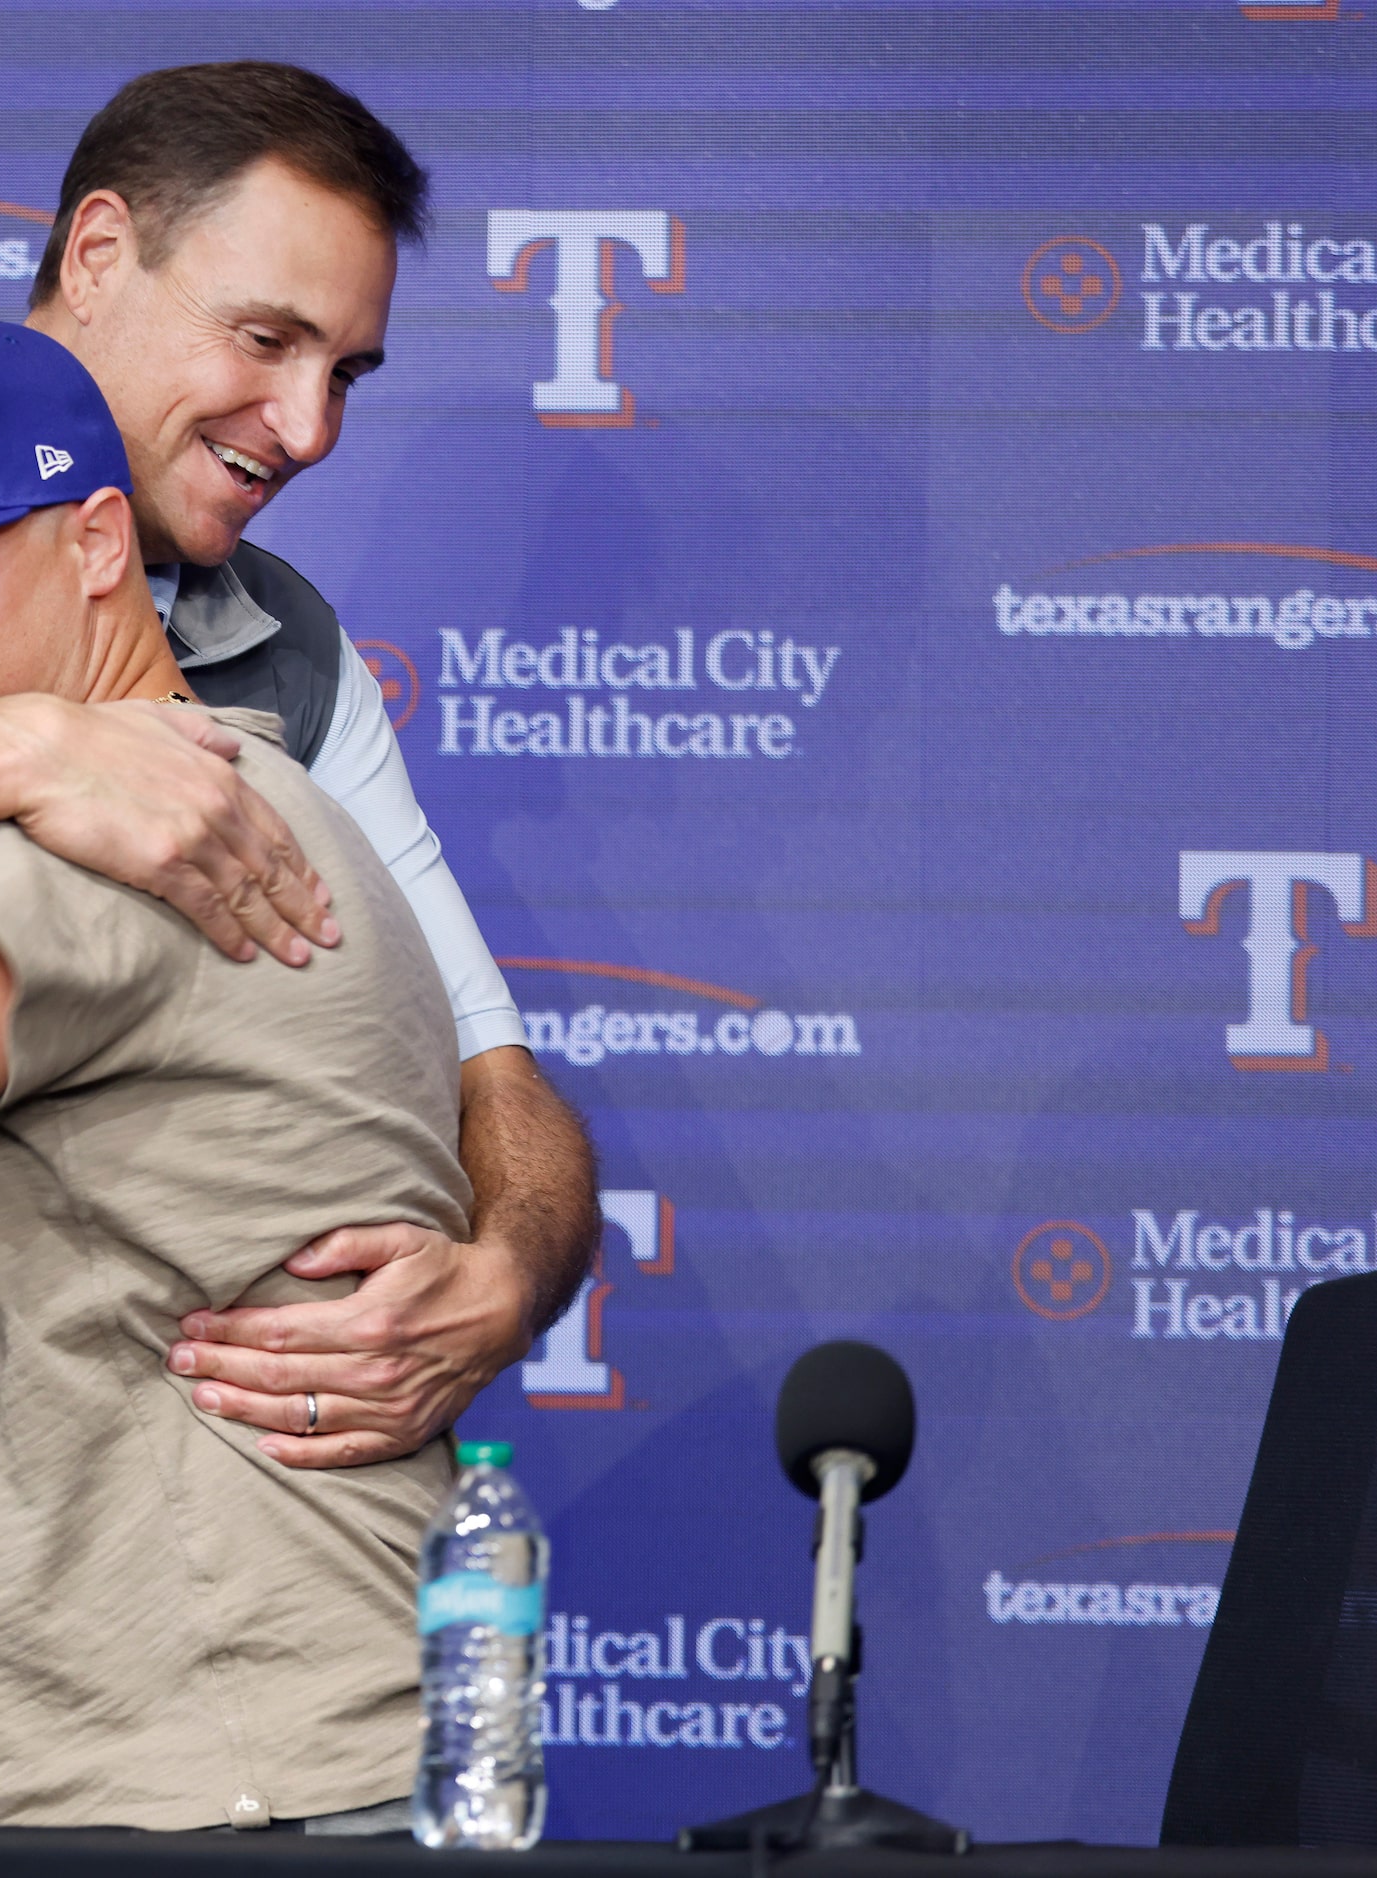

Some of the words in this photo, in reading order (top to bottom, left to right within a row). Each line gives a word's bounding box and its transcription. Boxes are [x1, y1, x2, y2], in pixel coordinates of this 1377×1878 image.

[438, 626, 696, 690] Medical
[704, 629, 841, 707] City
[437, 695, 796, 759] Healthcare
